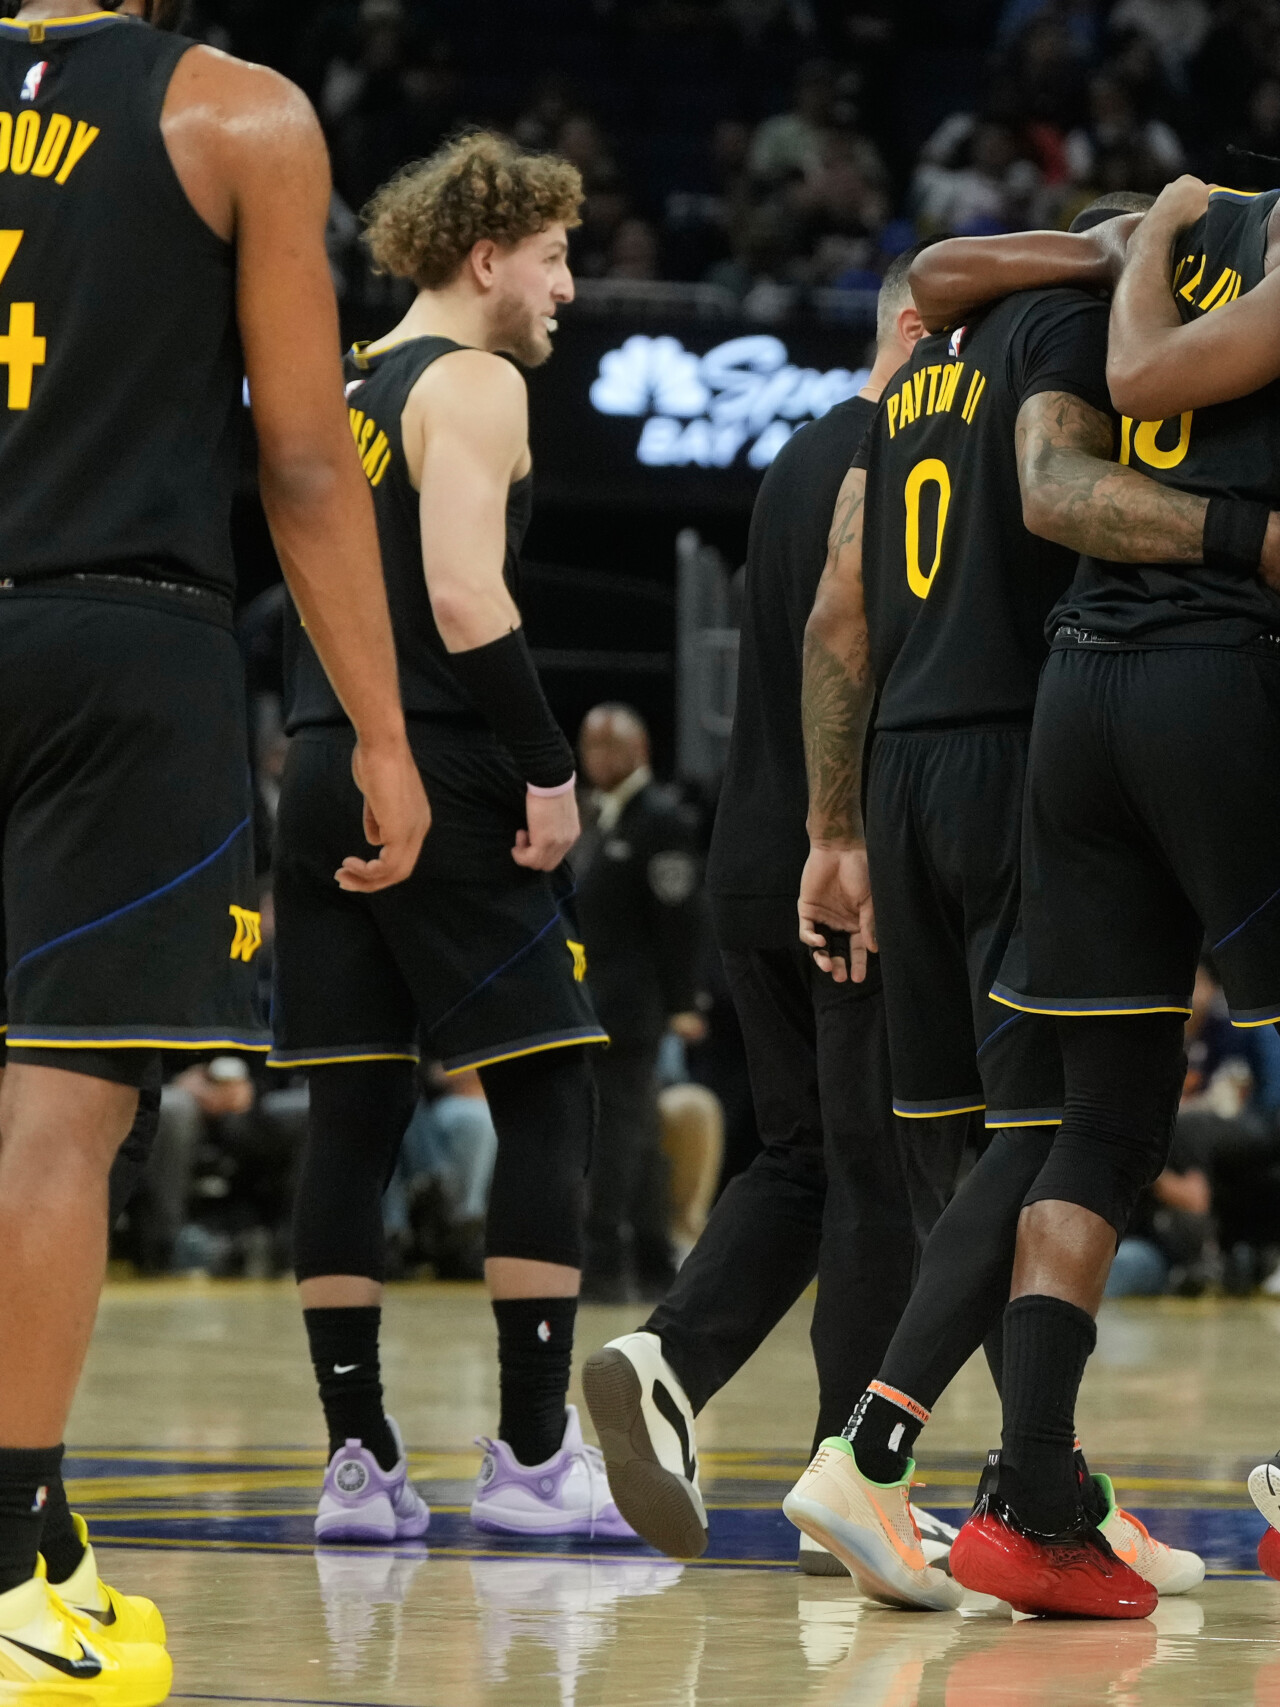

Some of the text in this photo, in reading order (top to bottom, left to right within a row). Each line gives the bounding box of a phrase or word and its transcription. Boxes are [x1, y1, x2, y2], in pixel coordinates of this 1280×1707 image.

[887, 361, 986, 439] PAYTON II
[904, 458, 951, 600] 0
